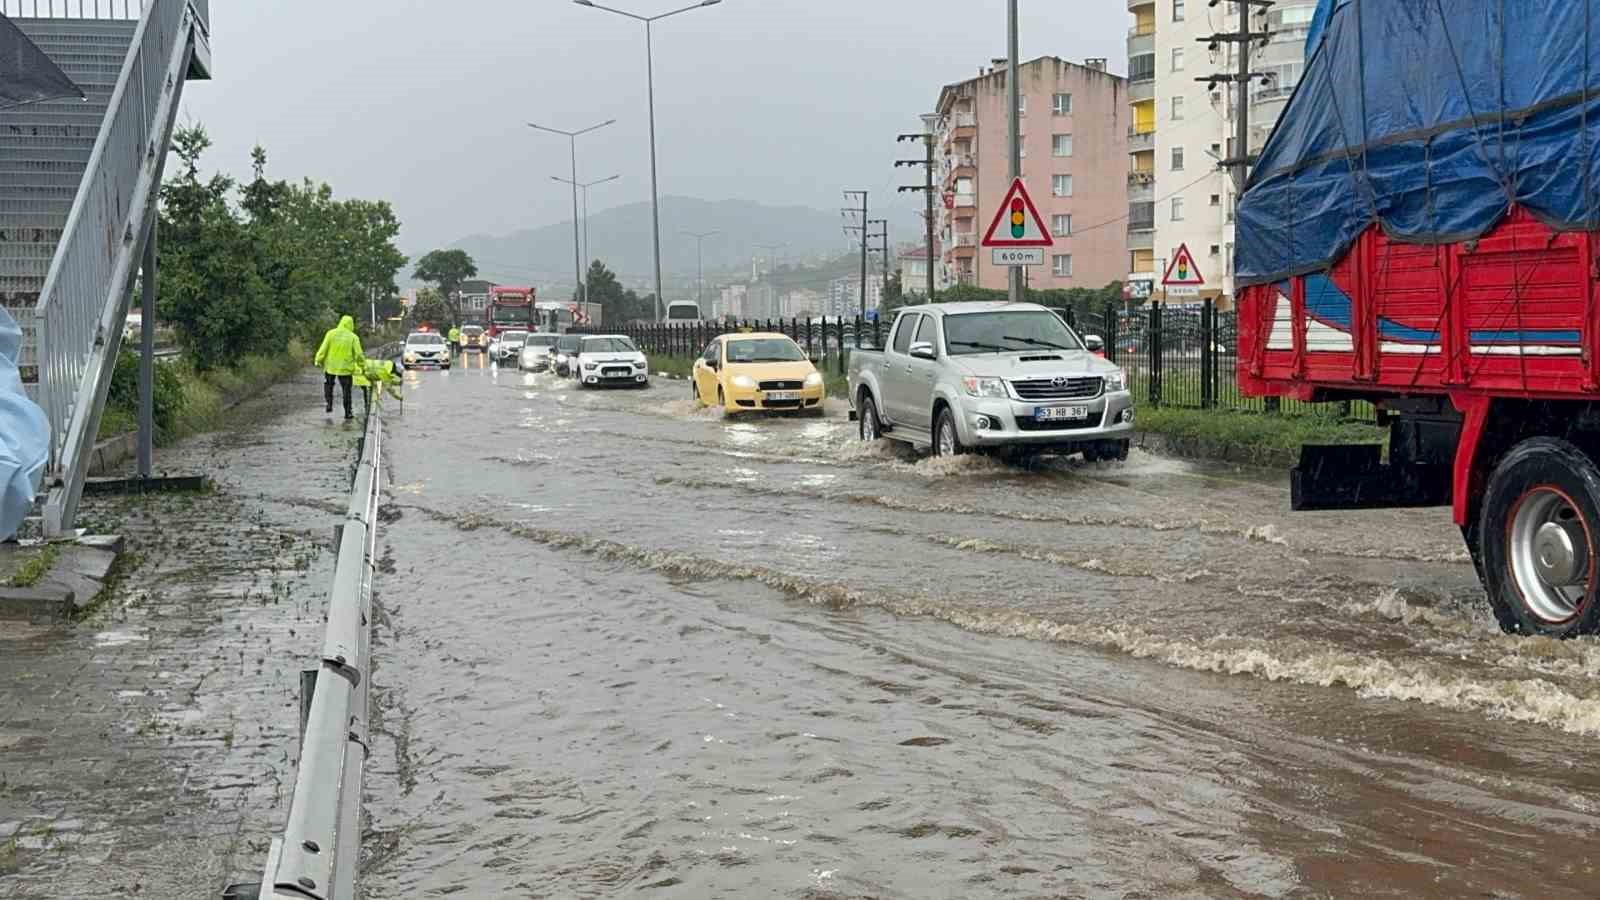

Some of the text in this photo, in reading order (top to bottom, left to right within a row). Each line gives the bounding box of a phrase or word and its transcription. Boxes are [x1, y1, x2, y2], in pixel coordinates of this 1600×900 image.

[1040, 407, 1087, 417] 53 HB 367
